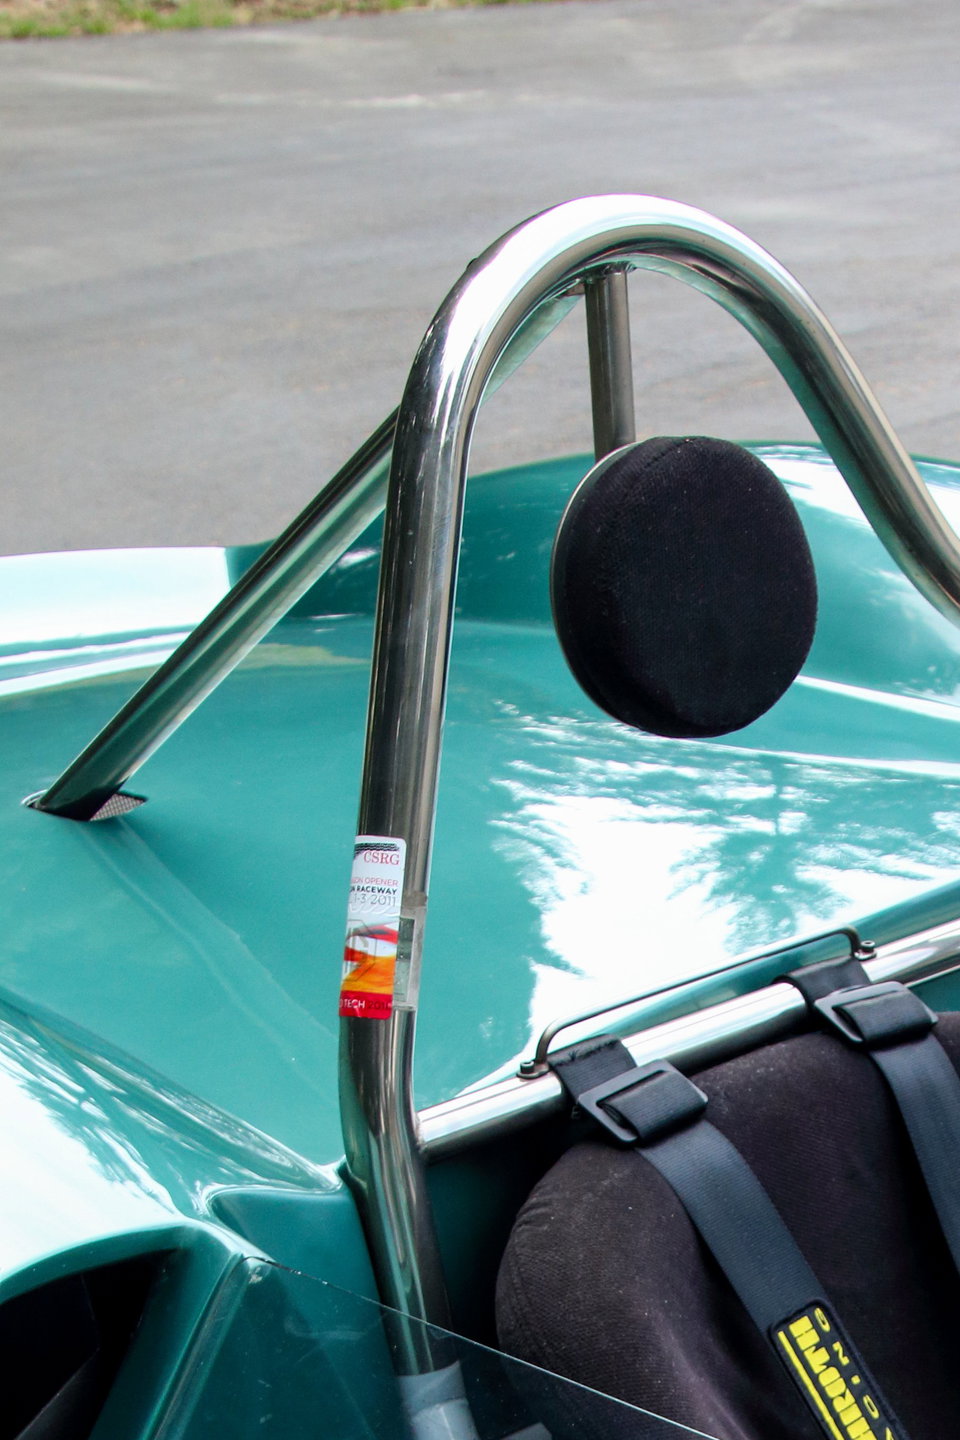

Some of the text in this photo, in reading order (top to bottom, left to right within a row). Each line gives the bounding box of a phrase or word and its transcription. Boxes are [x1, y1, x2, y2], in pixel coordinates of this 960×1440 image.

[363, 850, 400, 866] CSRG
[364, 877, 399, 888] OPENER
[356, 885, 398, 896] RACEWAY
[370, 894, 397, 908] 2011
[344, 998, 366, 1009] TECH
